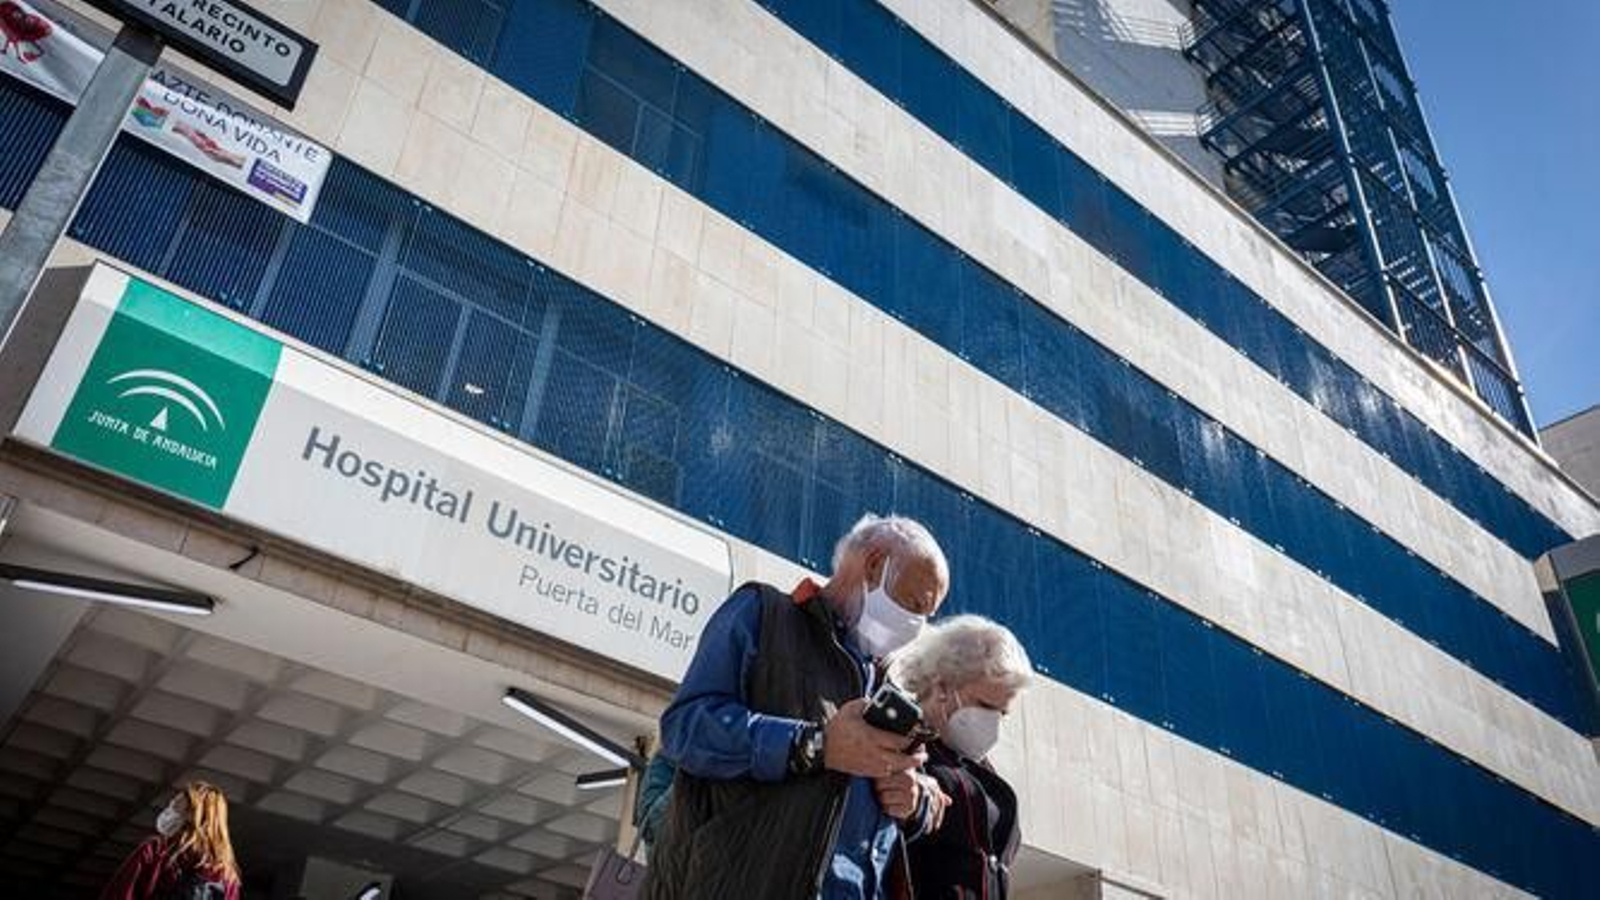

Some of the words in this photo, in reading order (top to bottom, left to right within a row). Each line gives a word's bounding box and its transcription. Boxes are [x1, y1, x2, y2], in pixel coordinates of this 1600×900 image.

[193, 0, 291, 57] RECINTO
[150, 70, 211, 103] AZTE
[233, 125, 281, 163] VIDA
[88, 410, 129, 434] JUNTA
[133, 426, 150, 443] DE
[302, 426, 474, 523] Hospital
[487, 501, 700, 615] Universitario
[518, 564, 601, 616] Puerta
[608, 602, 644, 632] del
[650, 615, 695, 651] Mar
